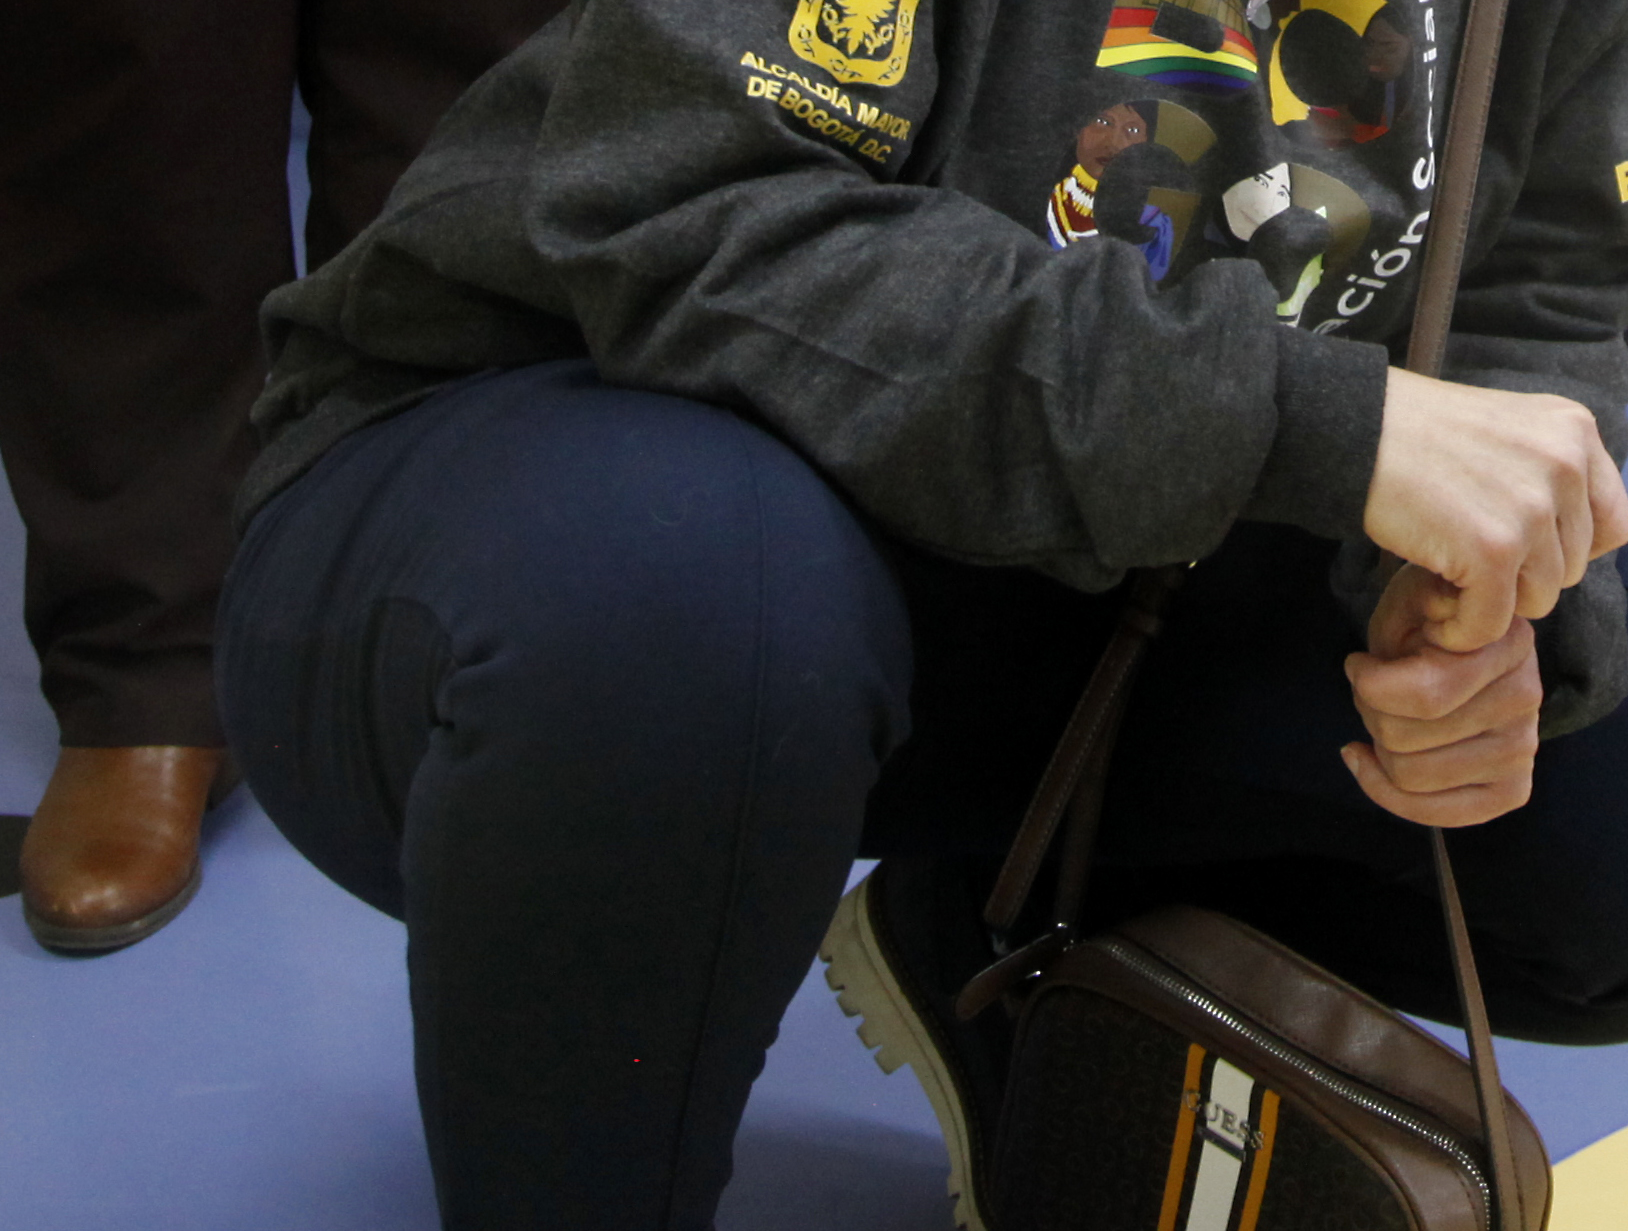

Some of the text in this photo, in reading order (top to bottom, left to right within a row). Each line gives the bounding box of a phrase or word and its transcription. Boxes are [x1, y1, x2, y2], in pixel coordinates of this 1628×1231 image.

[742, 52, 852, 115] ALCALDÍA
[747, 76, 782, 101] DE
[780, 87, 863, 146] BOGOTÁ
